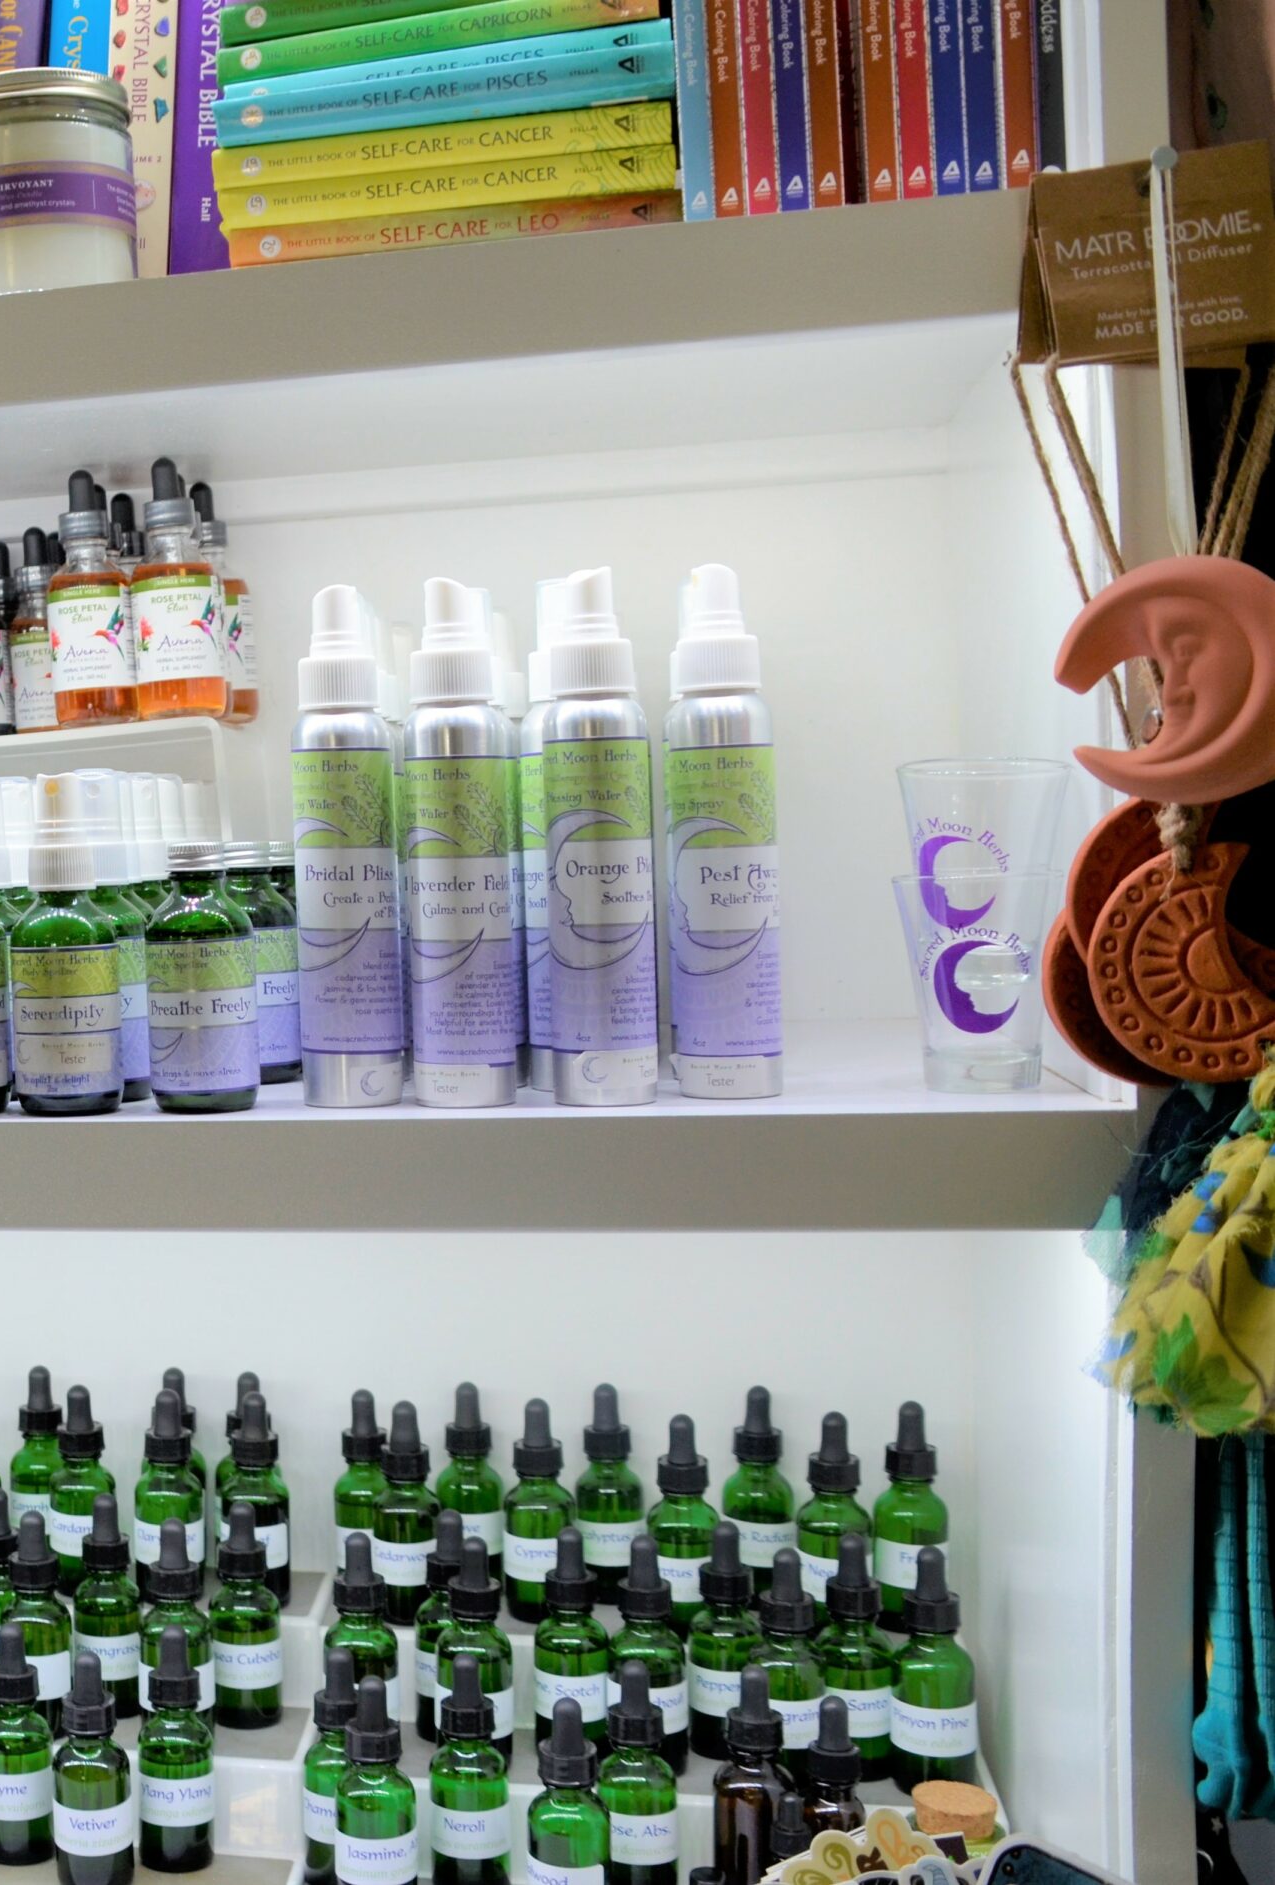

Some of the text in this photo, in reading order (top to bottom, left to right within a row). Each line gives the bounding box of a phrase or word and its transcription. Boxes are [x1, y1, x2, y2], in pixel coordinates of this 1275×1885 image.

[354, 6, 553, 49] SELF-CARE CAPRICORN
[969, 26, 983, 53] Book
[748, 44, 761, 71] Book
[781, 41, 794, 69] Book
[813, 38, 826, 65] Book
[685, 60, 700, 87] Book
[716, 56, 729, 84] Book
[131, 78, 148, 123] BIBLE
[362, 70, 549, 109] SELF-CARE PISCES
[197, 88, 218, 148] BIBLE
[287, 125, 554, 166] LITTLE BOOK SELF-CARE CANCER
[291, 166, 558, 204] LITTLE BOOK SELF-CARE CANCER
[200, 196, 212, 223] Hall
[305, 213, 560, 247] LITTLE BOOK SELF-CARE LEO
[1054, 231, 1137, 264] MATR
[1071, 243, 1254, 281] Terracotta Diffuser
[1094, 320, 1145, 340] MADE
[1190, 307, 1249, 328] GOOD.
[58, 603, 108, 616] ROSE PETAL
[151, 593, 203, 605] ROSE PETAL
[321, 759, 359, 773] Herbs
[562, 749, 638, 764] Moon Herbs
[678, 756, 755, 773] Moon Herbs
[307, 799, 338, 811] Water
[586, 789, 623, 802] Water
[688, 799, 725, 816] Spray
[926, 817, 1011, 873] Moon Herbs
[305, 863, 355, 882] Bridal
[564, 859, 630, 884] Orange
[699, 863, 742, 886] Pest
[411, 876, 476, 896] Lavender
[323, 891, 364, 908] Create
[709, 891, 752, 908] Relief
[948, 922, 1000, 942] Moon
[262, 980, 297, 1001] Freely
[20, 1004, 105, 1028] Serendipity
[151, 998, 252, 1020] Breathe Freely
[59, 1051, 87, 1065] Tester
[431, 1080, 460, 1094] Tester
[705, 1072, 736, 1087] Tester
[556, 1683, 601, 1700] Scotch
[892, 1707, 970, 1731] Pinyon Pine
[141, 1783, 212, 1802] Ylang Ylang
[69, 1815, 118, 1831] Vetiver
[443, 1816, 486, 1832] Neroli
[346, 1843, 407, 1860] Jasmine,
